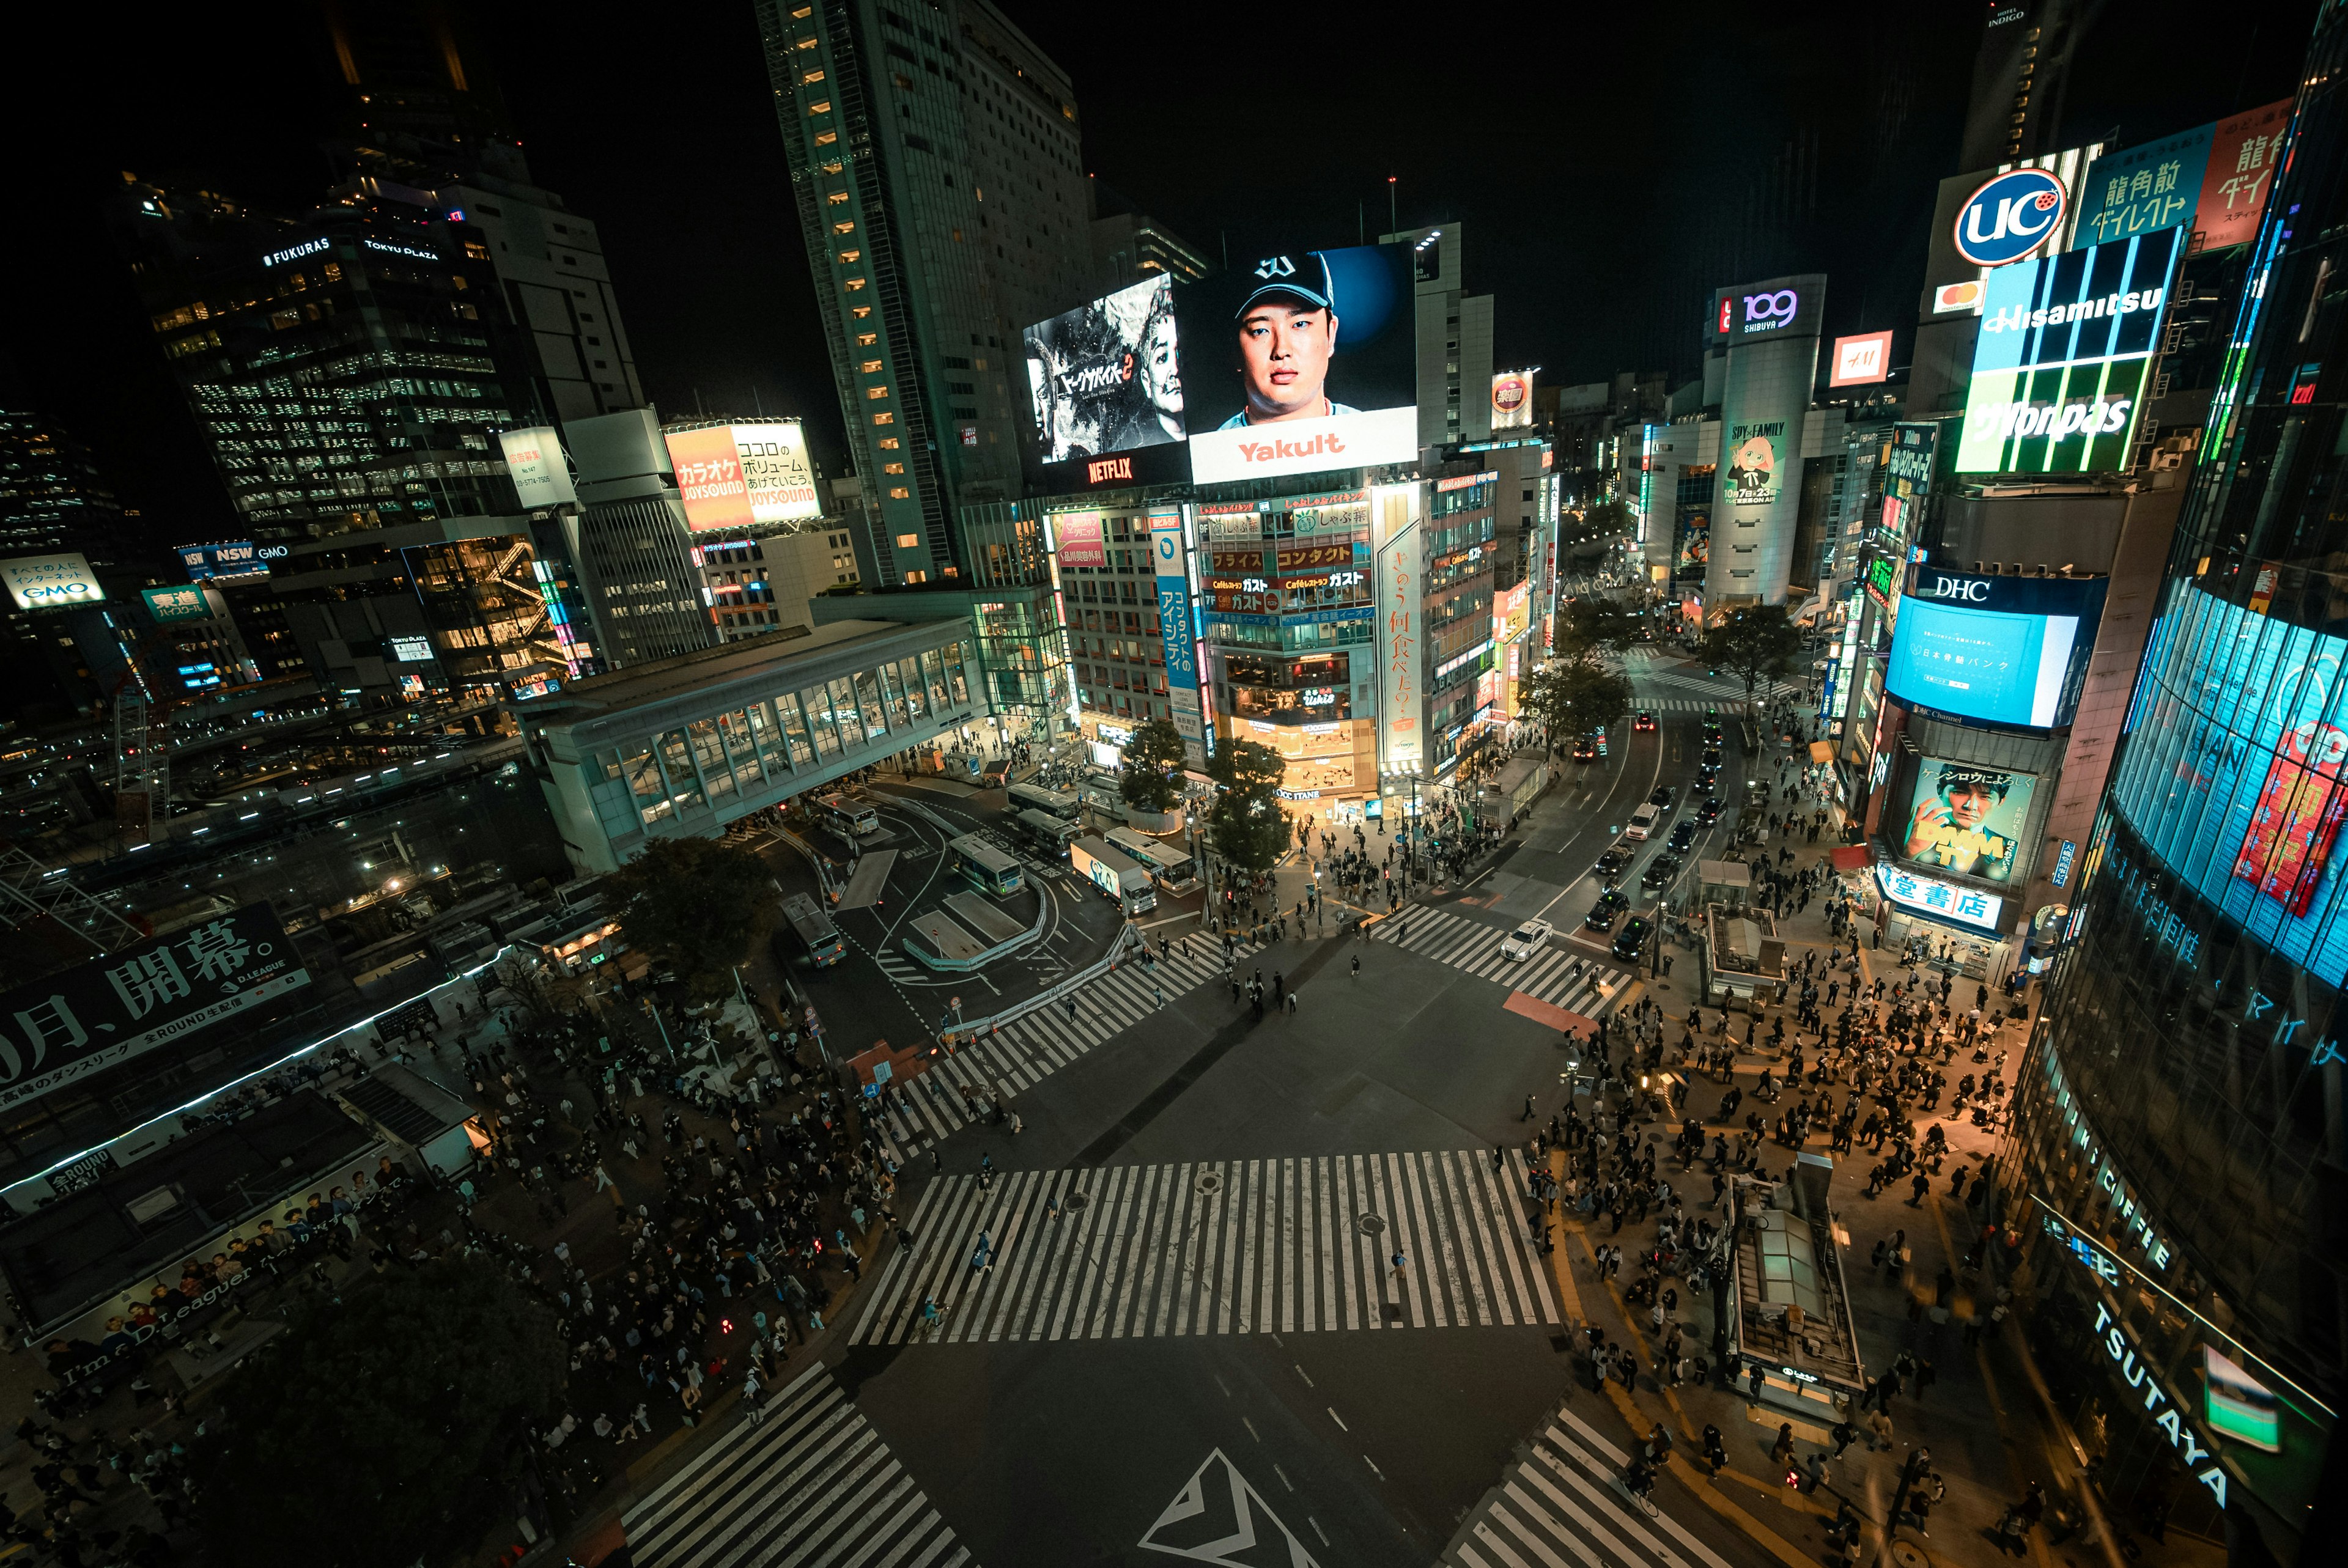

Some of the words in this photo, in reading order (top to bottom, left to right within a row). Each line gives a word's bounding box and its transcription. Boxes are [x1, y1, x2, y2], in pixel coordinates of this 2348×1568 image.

[1988, 11, 2024, 28] INDIGO
[1998, 8, 2016, 17] HOTEL
[2106, 160, 2180, 208] 龍角散
[1965, 190, 2051, 244] UC
[2091, 196, 2186, 239] ダイレクト
[273, 238, 330, 263] FUKURAS
[365, 240, 401, 254] TOKYU
[404, 249, 438, 260] PLAZA
[1744, 290, 1797, 328] 109
[1983, 288, 2163, 333] Hisamitsu
[1744, 321, 1776, 333] SHIBUYA
[1848, 350, 1874, 367] H&M
[509, 449, 541, 464] 広告募集
[738, 443, 789, 458] ココロの
[1238, 433, 1345, 463] Yakult
[677, 459, 738, 485] カラオケ
[743, 460, 808, 474] ボリューム、
[1088, 458, 1132, 484] NETFLIX
[516, 475, 550, 487] 03-5774-7505
[747, 474, 812, 489] あげていこう。
[685, 480, 744, 501] JOYSOUND
[750, 488, 815, 506] JOYSOUND
[1200, 502, 1254, 514] しゃぶしゃぶバイキング
[1285, 492, 1365, 509] しゃぶしゃぶバイキング
[1072, 517, 1097, 529] 品川スキン
[1152, 518, 1176, 528] 当ビル5F
[1320, 507, 1367, 526] しゃぶ葉
[1074, 526, 1096, 537] クリニック
[1200, 525, 1208, 533] 9F
[1227, 519, 1258, 533] しゃぶ葉
[216, 547, 253, 562] NSW
[259, 546, 287, 559] GMO
[704, 543, 722, 552] カラオケ
[724, 540, 748, 550] JOYSOUND
[185, 553, 204, 565] NSW
[1064, 550, 1102, 562] 品川美容外科
[1213, 553, 1261, 568] プライス
[1279, 547, 1350, 566] コンタクト
[10, 562, 79, 576] すべての人に
[15, 571, 82, 584] インターネット
[1242, 580, 1268, 592] ガスト
[1286, 578, 1327, 589] Caféレストラン
[1329, 572, 1364, 587] ガスト
[23, 583, 88, 598] GMO
[1935, 577, 1990, 602] DHC
[151, 590, 199, 608] 東進
[1205, 595, 1216, 605] 7F
[1232, 594, 1261, 610] ガスト
[160, 605, 203, 617] ハイスクール
[1224, 615, 1267, 624] 英会話イーオン
[1311, 609, 1372, 621] 英会話イーオン
[1161, 592, 1180, 671] アイシティ
[1175, 592, 1191, 672] コンタクトの
[1922, 649, 2009, 671] 日本骨髄バンク
[1474, 705, 1490, 723] LUSH
[1932, 711, 1962, 723] Channel
[1921, 768, 2032, 787] ケンシロウによろしく
[1916, 822, 2004, 858] DMM
[1936, 845, 1979, 869] TV
[237, 959, 286, 984] D.LEAGUE
[64, 1353, 111, 1387] I'm
[2094, 1301, 2226, 1509] TSUTAYA
